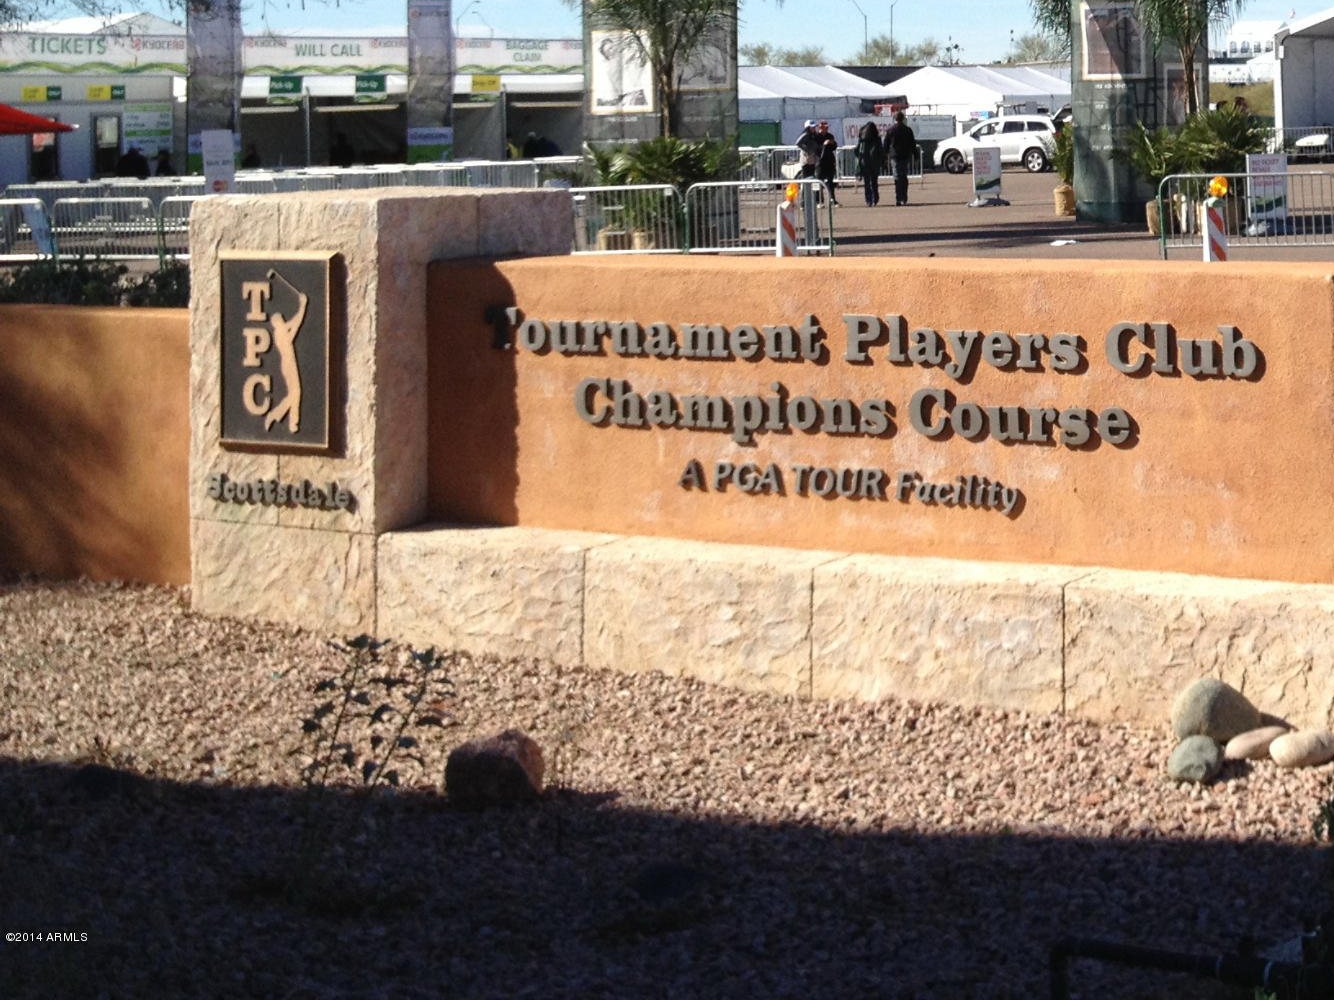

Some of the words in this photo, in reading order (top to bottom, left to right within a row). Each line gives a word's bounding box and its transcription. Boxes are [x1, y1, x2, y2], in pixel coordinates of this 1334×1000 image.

[28, 36, 106, 54] TICKETS
[295, 43, 325, 57] WILL
[330, 43, 363, 57] CALL
[486, 305, 824, 362] Tournament
[842, 313, 1082, 380] Players
[1104, 321, 1259, 380] Club
[574, 377, 892, 444] Champions
[908, 387, 1133, 446] Course
[207, 471, 351, 509] Scottsdale
[678, 458, 705, 489] A
[712, 462, 783, 494] PGA
[791, 463, 885, 498] TOUR
[894, 469, 1020, 516] Facility
